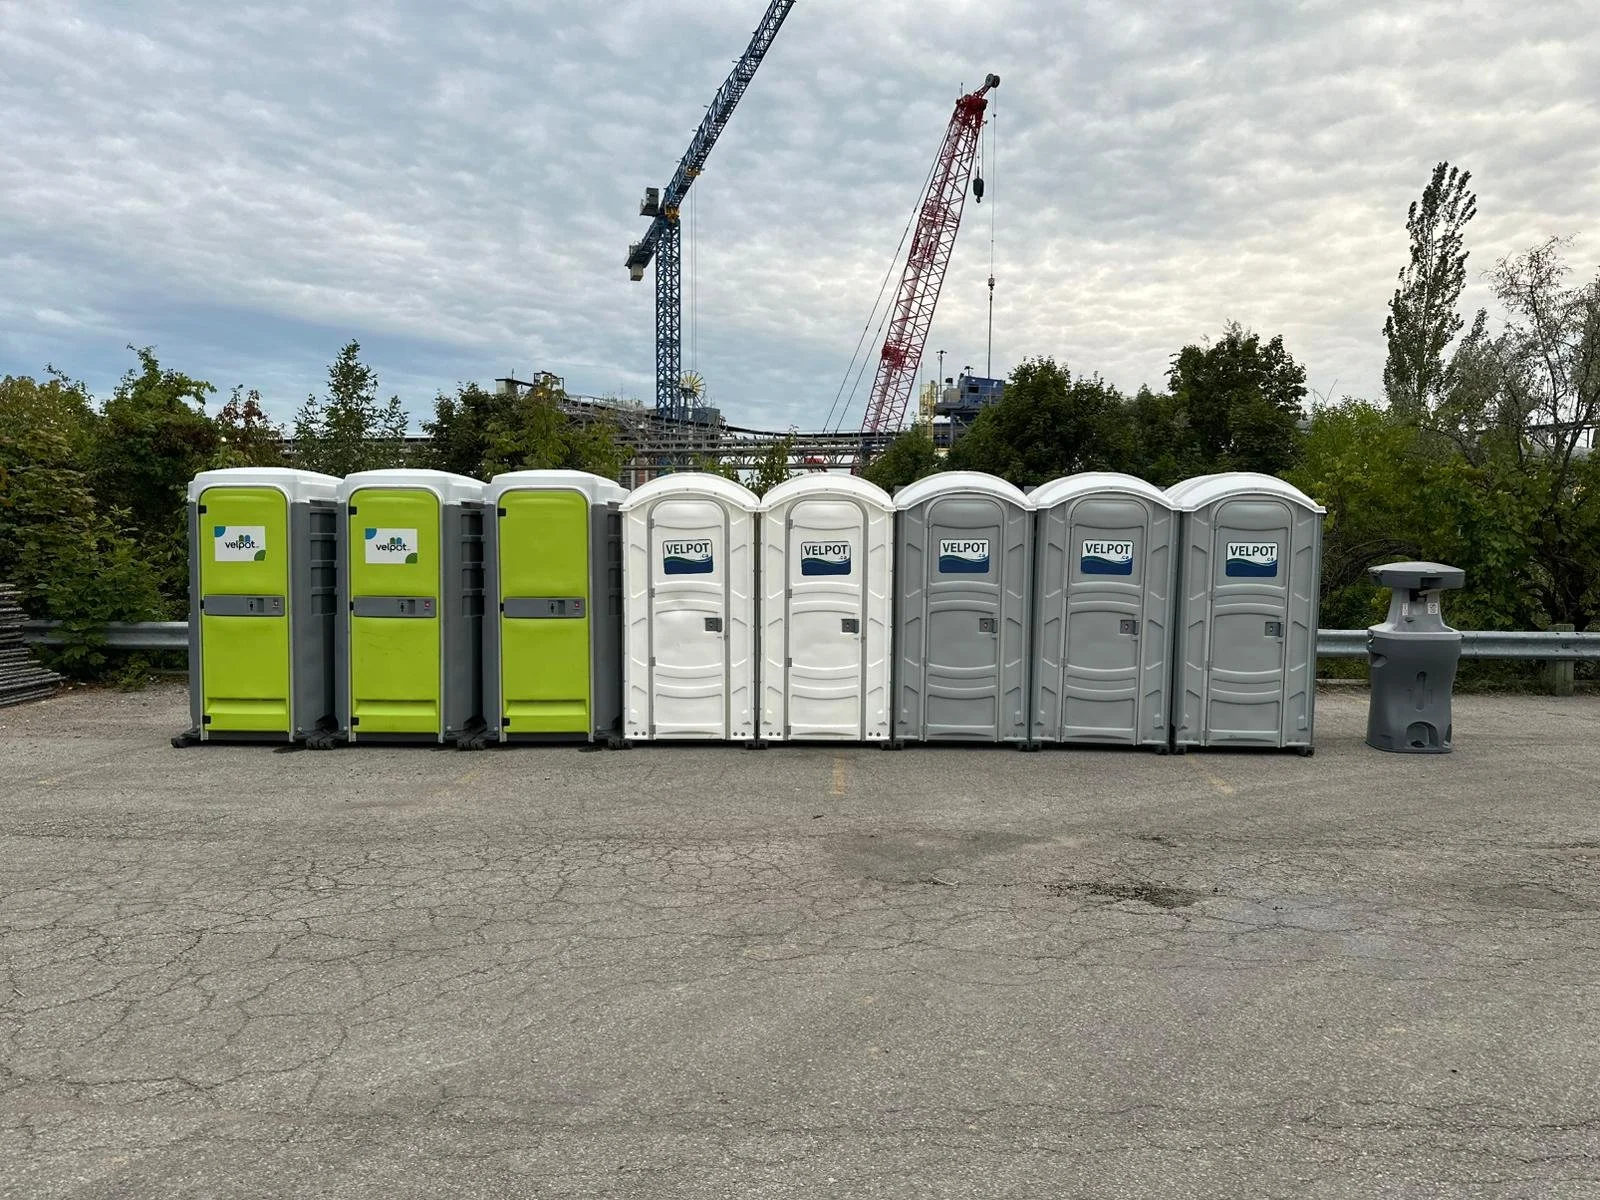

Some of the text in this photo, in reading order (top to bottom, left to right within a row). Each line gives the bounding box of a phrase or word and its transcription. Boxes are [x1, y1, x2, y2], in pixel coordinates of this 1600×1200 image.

[225, 540, 255, 550] velpot
[376, 543, 407, 552] velpot
[666, 543, 710, 554] VELPOT
[804, 545, 848, 555] VELPOT
[942, 543, 987, 553] VELPOT
[1085, 543, 1131, 554] VELPOT
[1230, 546, 1276, 556] VELPOT
